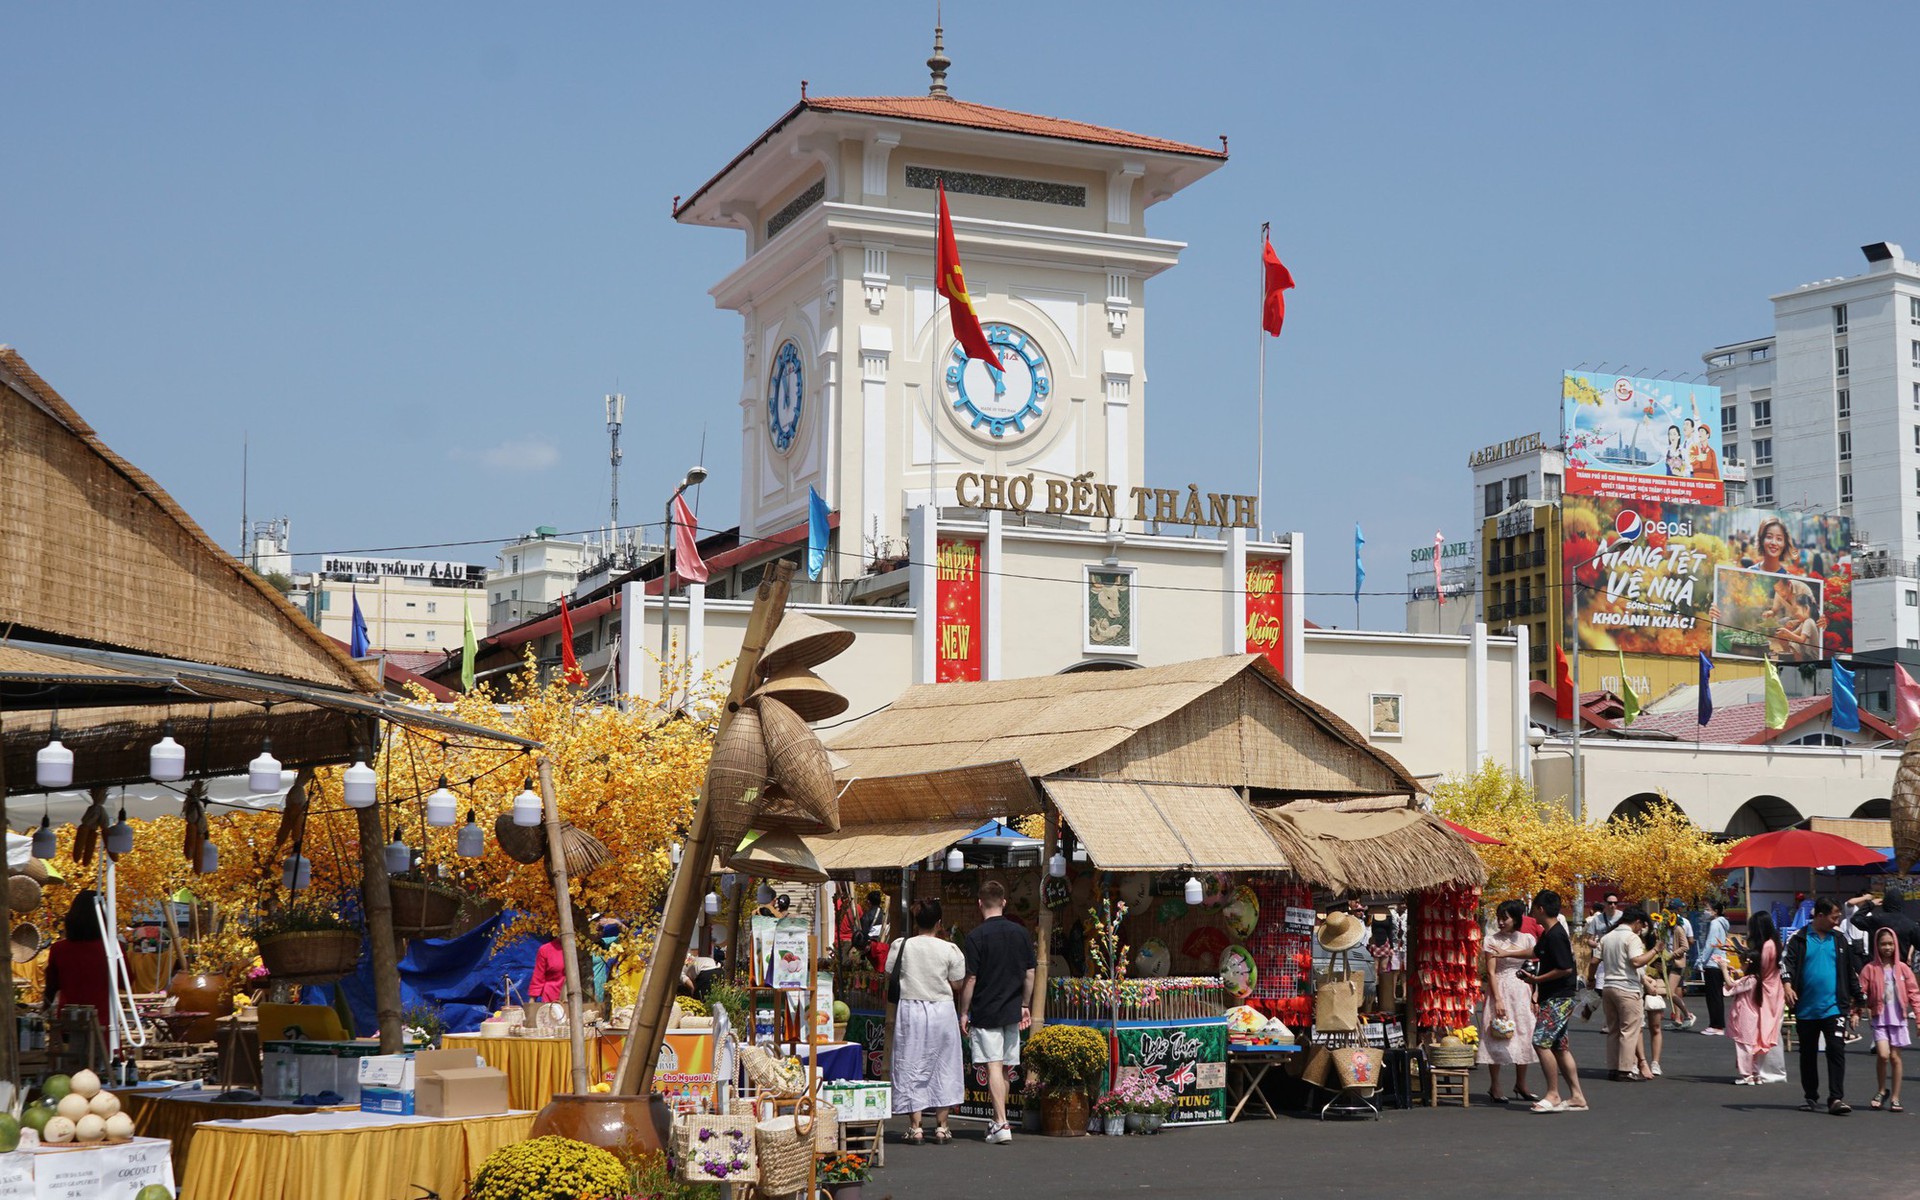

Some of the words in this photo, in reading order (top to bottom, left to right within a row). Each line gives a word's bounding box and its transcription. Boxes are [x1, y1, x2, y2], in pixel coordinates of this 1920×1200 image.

[988, 325, 1011, 343] 12
[946, 366, 960, 383] 9
[1035, 377, 1049, 395] 3
[990, 421, 1005, 436] 6
[1505, 432, 1541, 458] HOTEL
[956, 471, 1034, 516] CHỢ
[1046, 470, 1117, 518] BẾN
[1130, 483, 1258, 528] THÀNH
[1645, 520, 1692, 540] pepsi
[1441, 542, 1467, 558] ANH
[1592, 538, 1664, 570] MANG
[1666, 544, 1707, 575] TẾT
[937, 543, 975, 581] HAPPY
[1606, 569, 1645, 604] VỀ
[1647, 575, 1699, 607] NHÀ
[1652, 611, 1696, 629] KHẮC!
[942, 624, 970, 660] NEW
[118, 1165, 158, 1178] COCONUT
